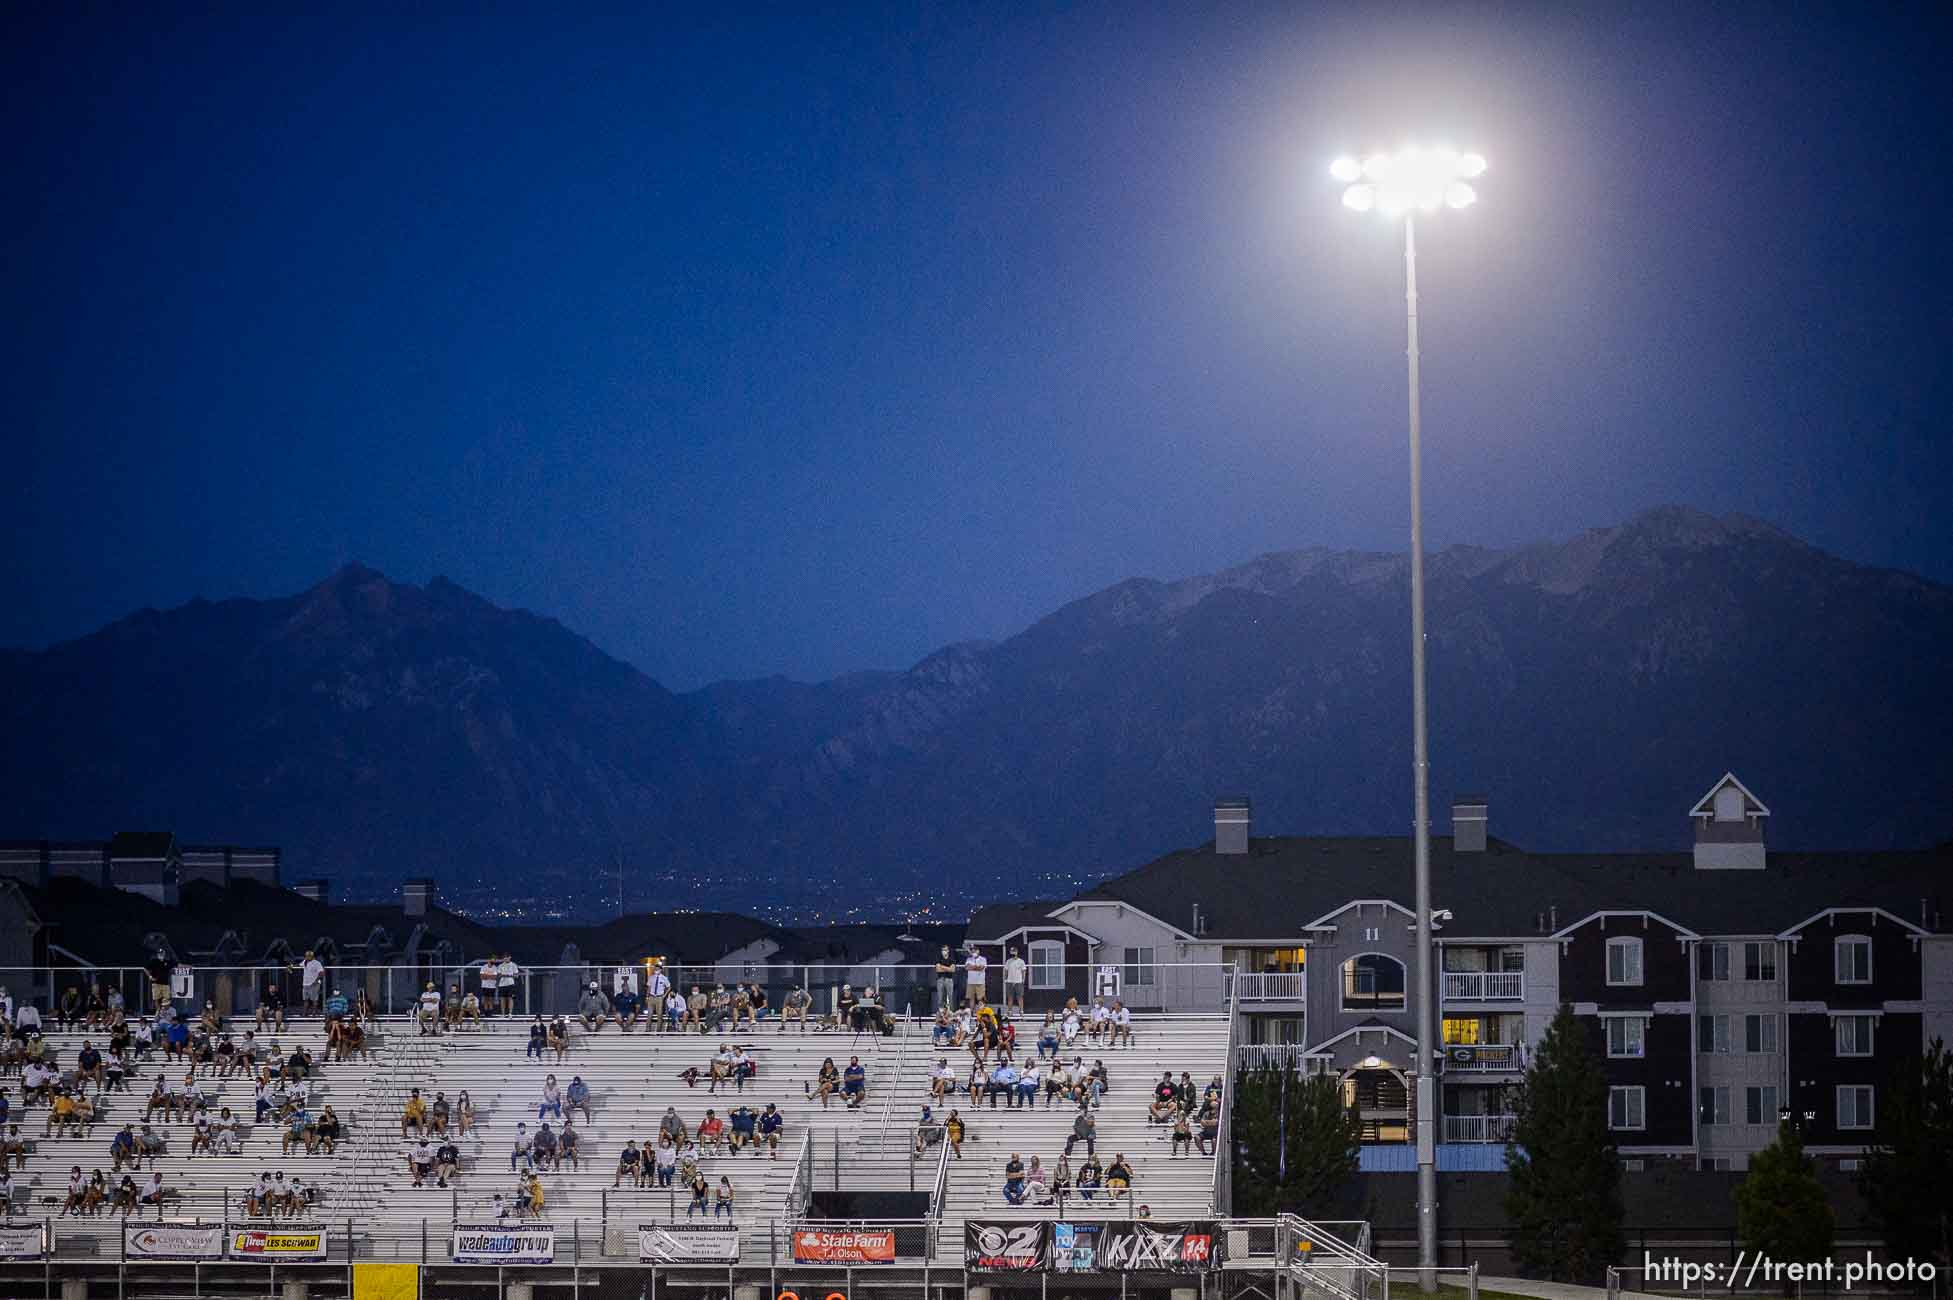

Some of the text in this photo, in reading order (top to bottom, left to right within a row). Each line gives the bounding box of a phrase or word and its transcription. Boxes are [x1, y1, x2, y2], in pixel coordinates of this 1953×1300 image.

[176, 976, 189, 997] J
[267, 1239, 280, 1247] LES
[837, 1248, 862, 1258] Olson
